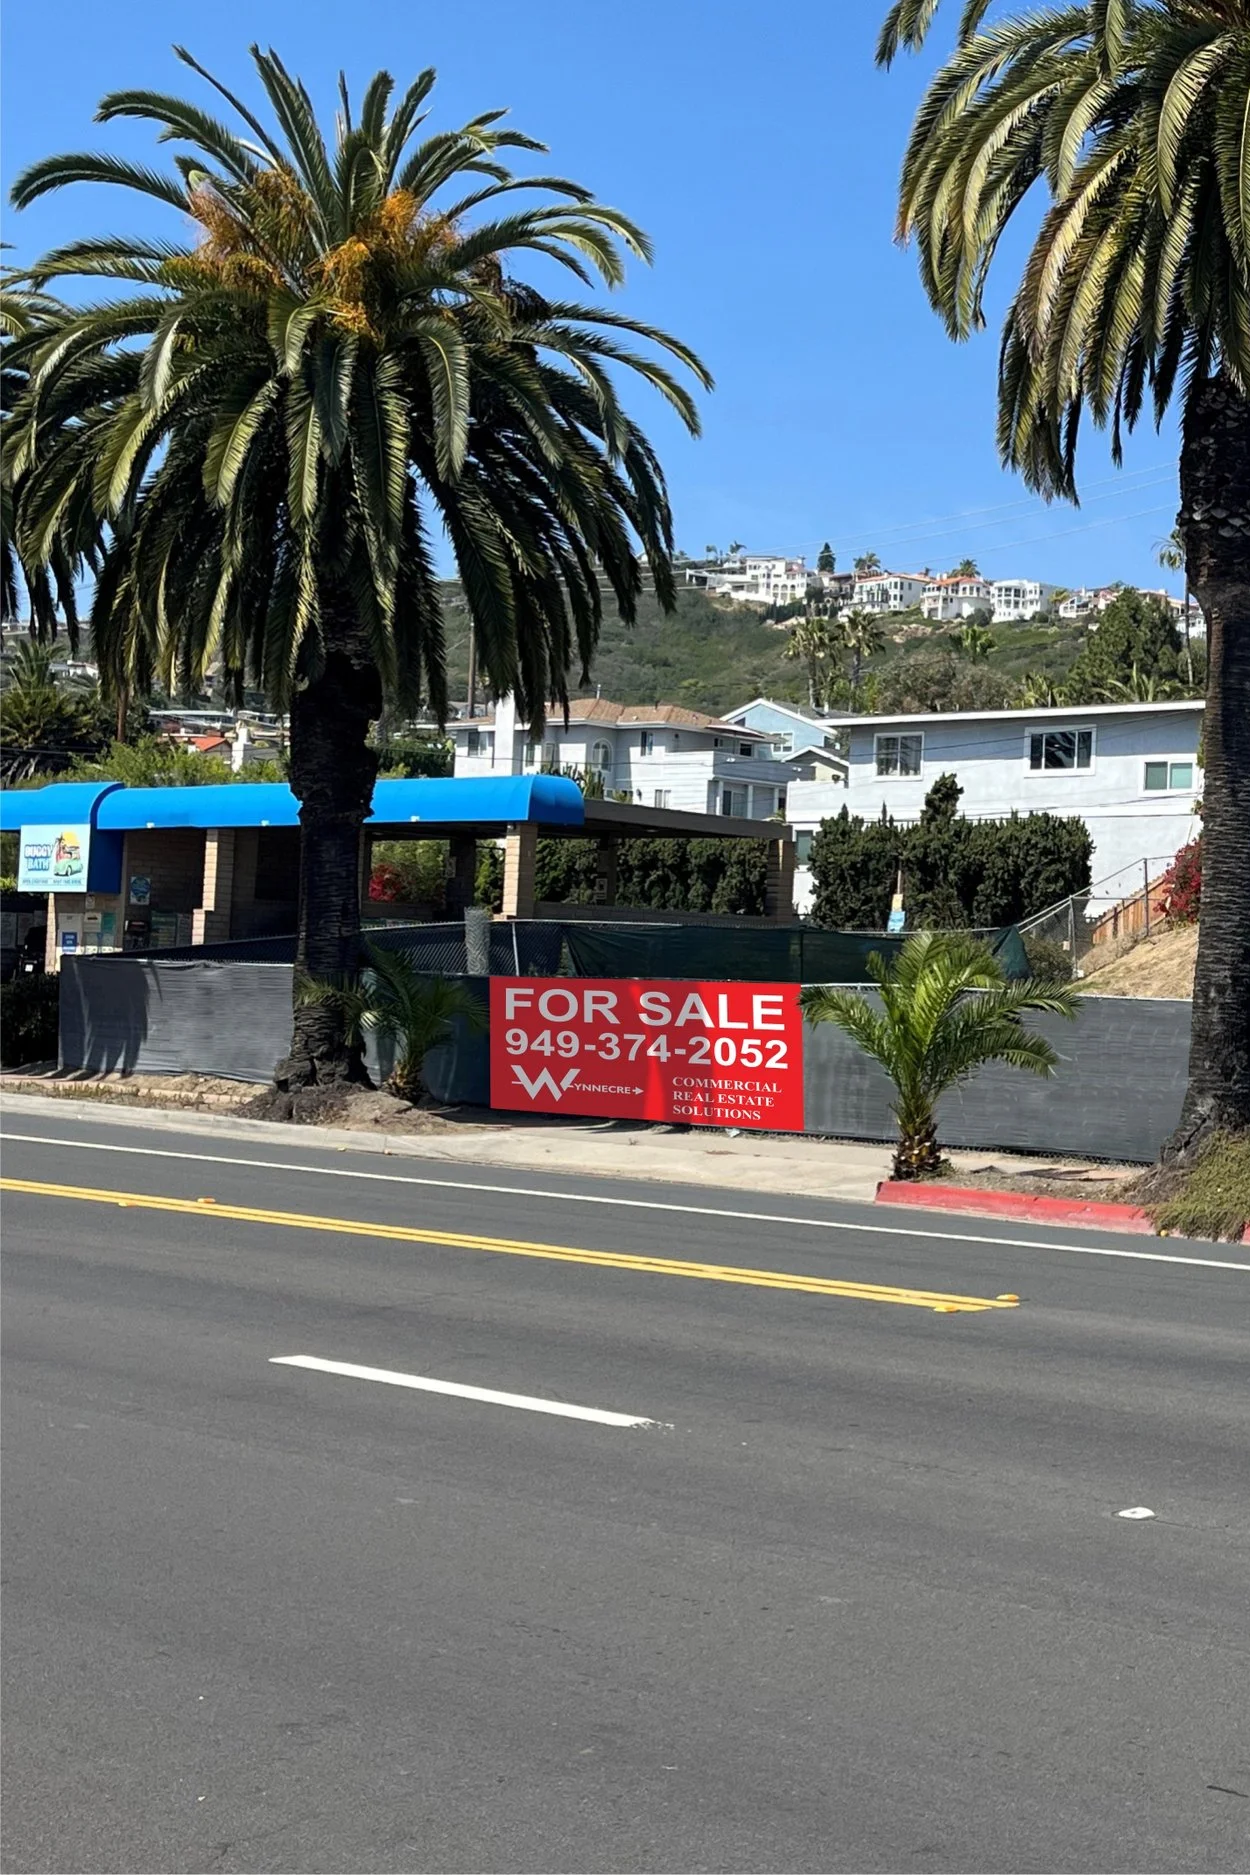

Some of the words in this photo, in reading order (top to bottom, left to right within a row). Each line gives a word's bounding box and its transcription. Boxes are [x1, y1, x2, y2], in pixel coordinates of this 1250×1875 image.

[24, 844, 52, 858] BUGGY
[27, 858, 50, 871] BATH
[505, 987, 621, 1025] FOR
[638, 991, 785, 1031] SALE
[505, 1028, 788, 1069] 949-374-2052
[672, 1076, 782, 1093] COMMERCIAL
[673, 1091, 714, 1103] REAL
[718, 1093, 775, 1107] ESTATE
[672, 1105, 761, 1121] SOLUTIONS
